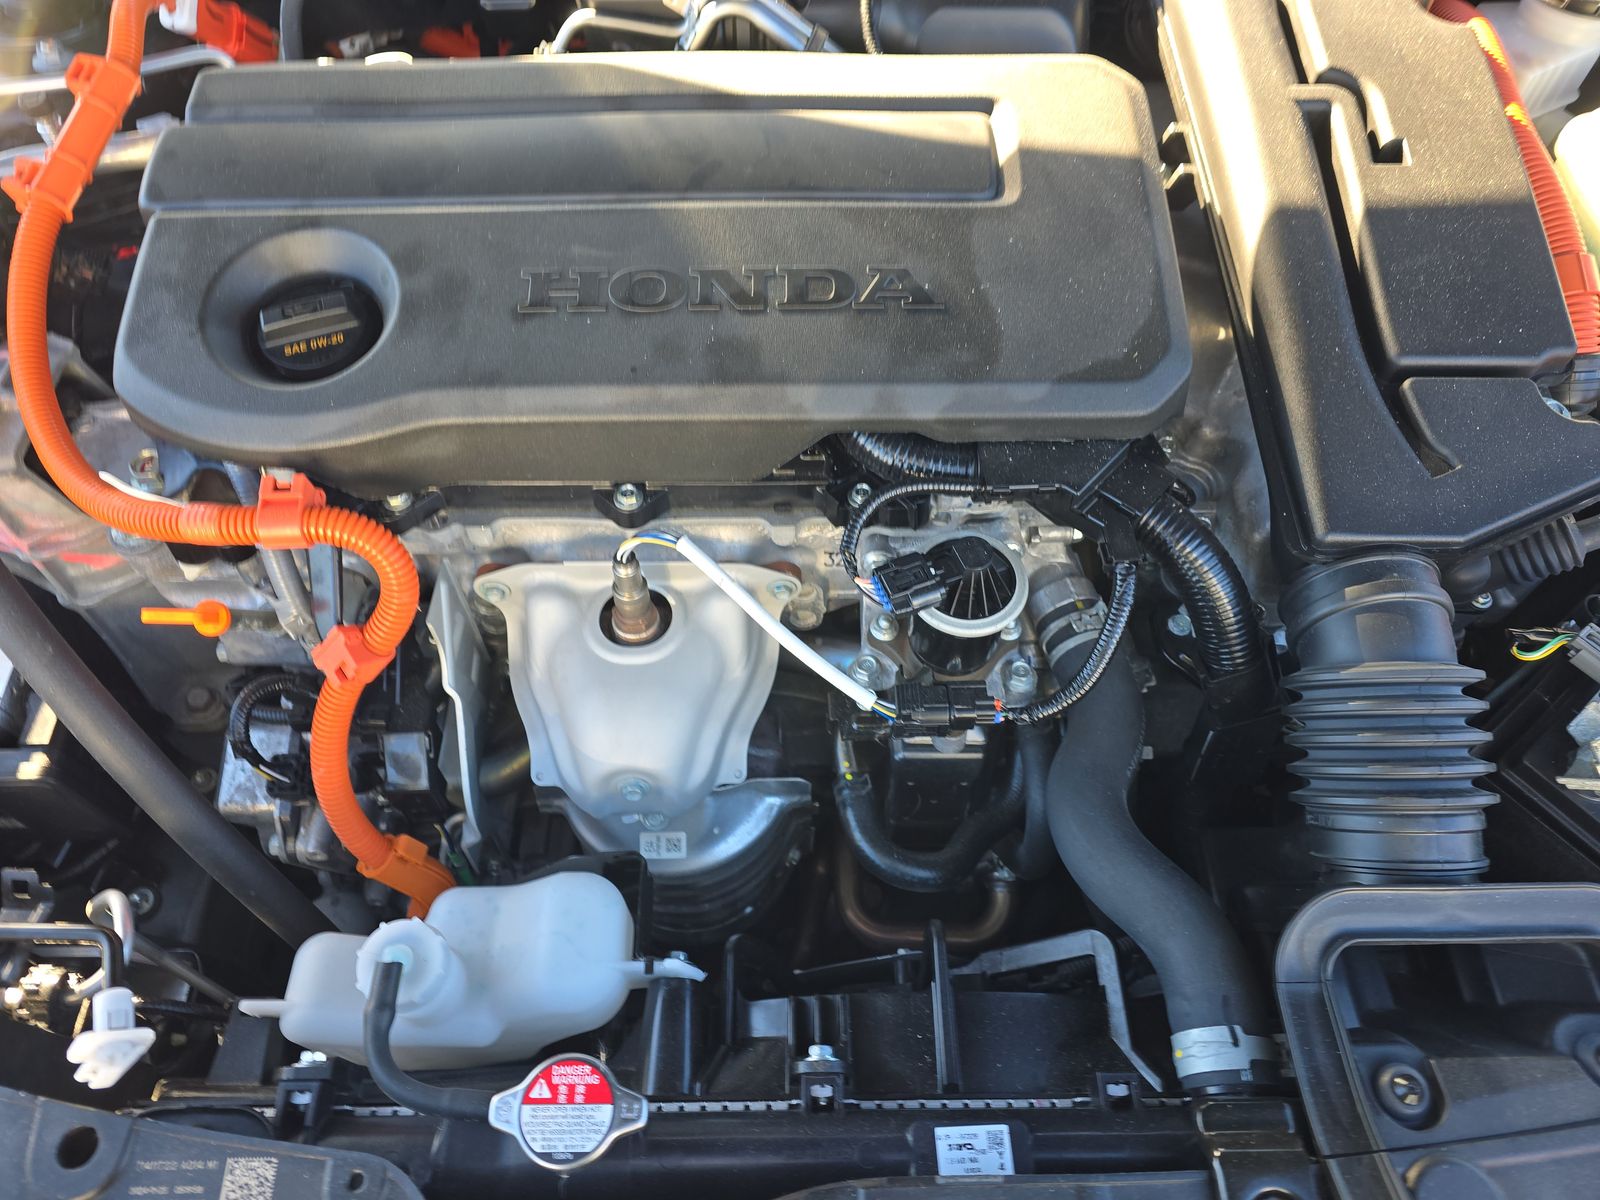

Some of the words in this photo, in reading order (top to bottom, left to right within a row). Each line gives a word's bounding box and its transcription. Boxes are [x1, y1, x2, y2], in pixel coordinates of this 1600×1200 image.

[517, 265, 945, 313] HONDA
[284, 340, 307, 356] SAE
[311, 332, 344, 351] 0W-20
[551, 1065, 593, 1075] DANGER
[551, 1075, 600, 1084] WARNING
